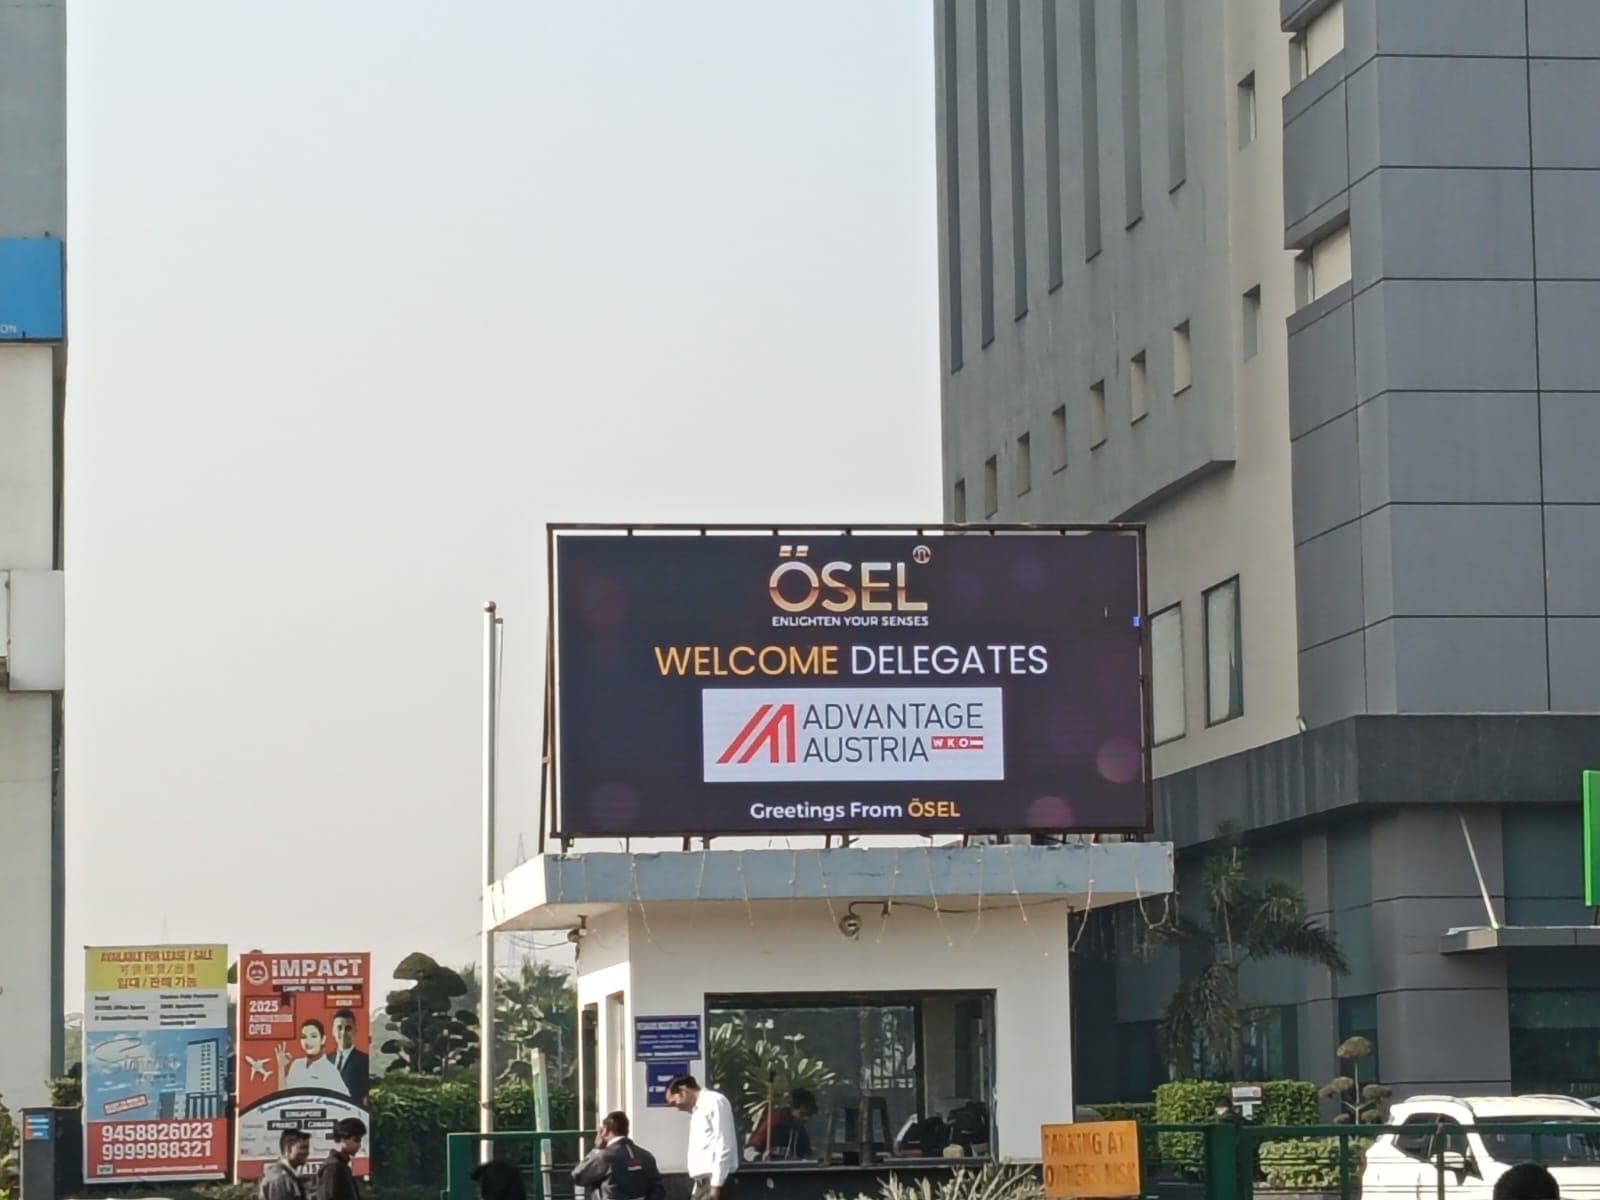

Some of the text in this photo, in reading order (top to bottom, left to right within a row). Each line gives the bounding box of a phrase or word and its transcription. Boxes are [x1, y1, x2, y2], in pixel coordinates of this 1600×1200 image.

[769, 545, 928, 612] ÖSEL
[772, 616, 929, 627] ENLIGHTEN YOUR SENSES
[654, 645, 1048, 676] WELCOME DELEGATES
[802, 703, 984, 729] ADVANTAGE
[803, 737, 929, 763] AUSTRIA
[750, 802, 845, 821] Greetings
[850, 802, 902, 818] From
[145, 951, 160, 961] FOR
[162, 951, 185, 961] LEASE
[194, 949, 213, 960] SALE
[249, 1000, 279, 1013] 2025
[248, 1024, 272, 1035] OPEN
[102, 1122, 213, 1142] 9458826023
[102, 1140, 211, 1160] 9999988321
